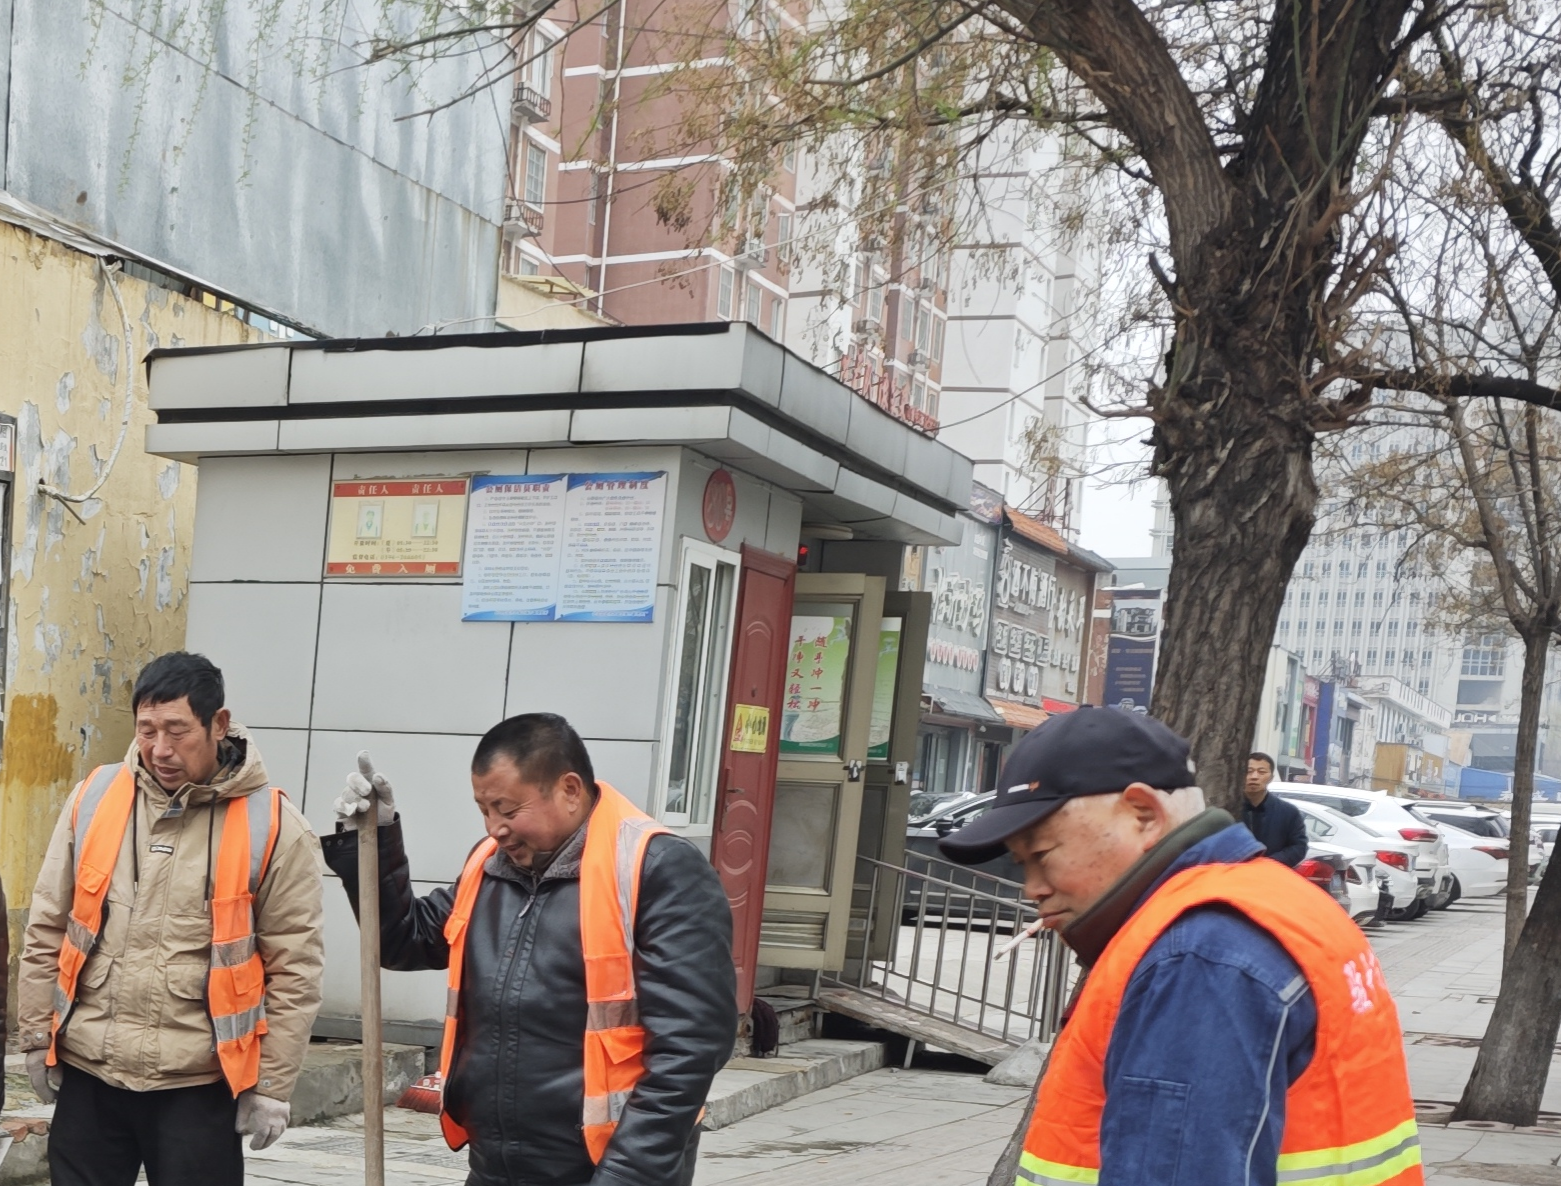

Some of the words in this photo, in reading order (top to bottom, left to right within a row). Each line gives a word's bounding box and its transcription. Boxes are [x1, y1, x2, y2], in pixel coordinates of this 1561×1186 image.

[358, 485, 389, 495] 责任人
[411, 483, 444, 494] 责任人
[583, 480, 650, 491] 公厕管理制度
[345, 563, 437, 575] 免费入厕
[807, 635, 828, 711] 随手冲一冲
